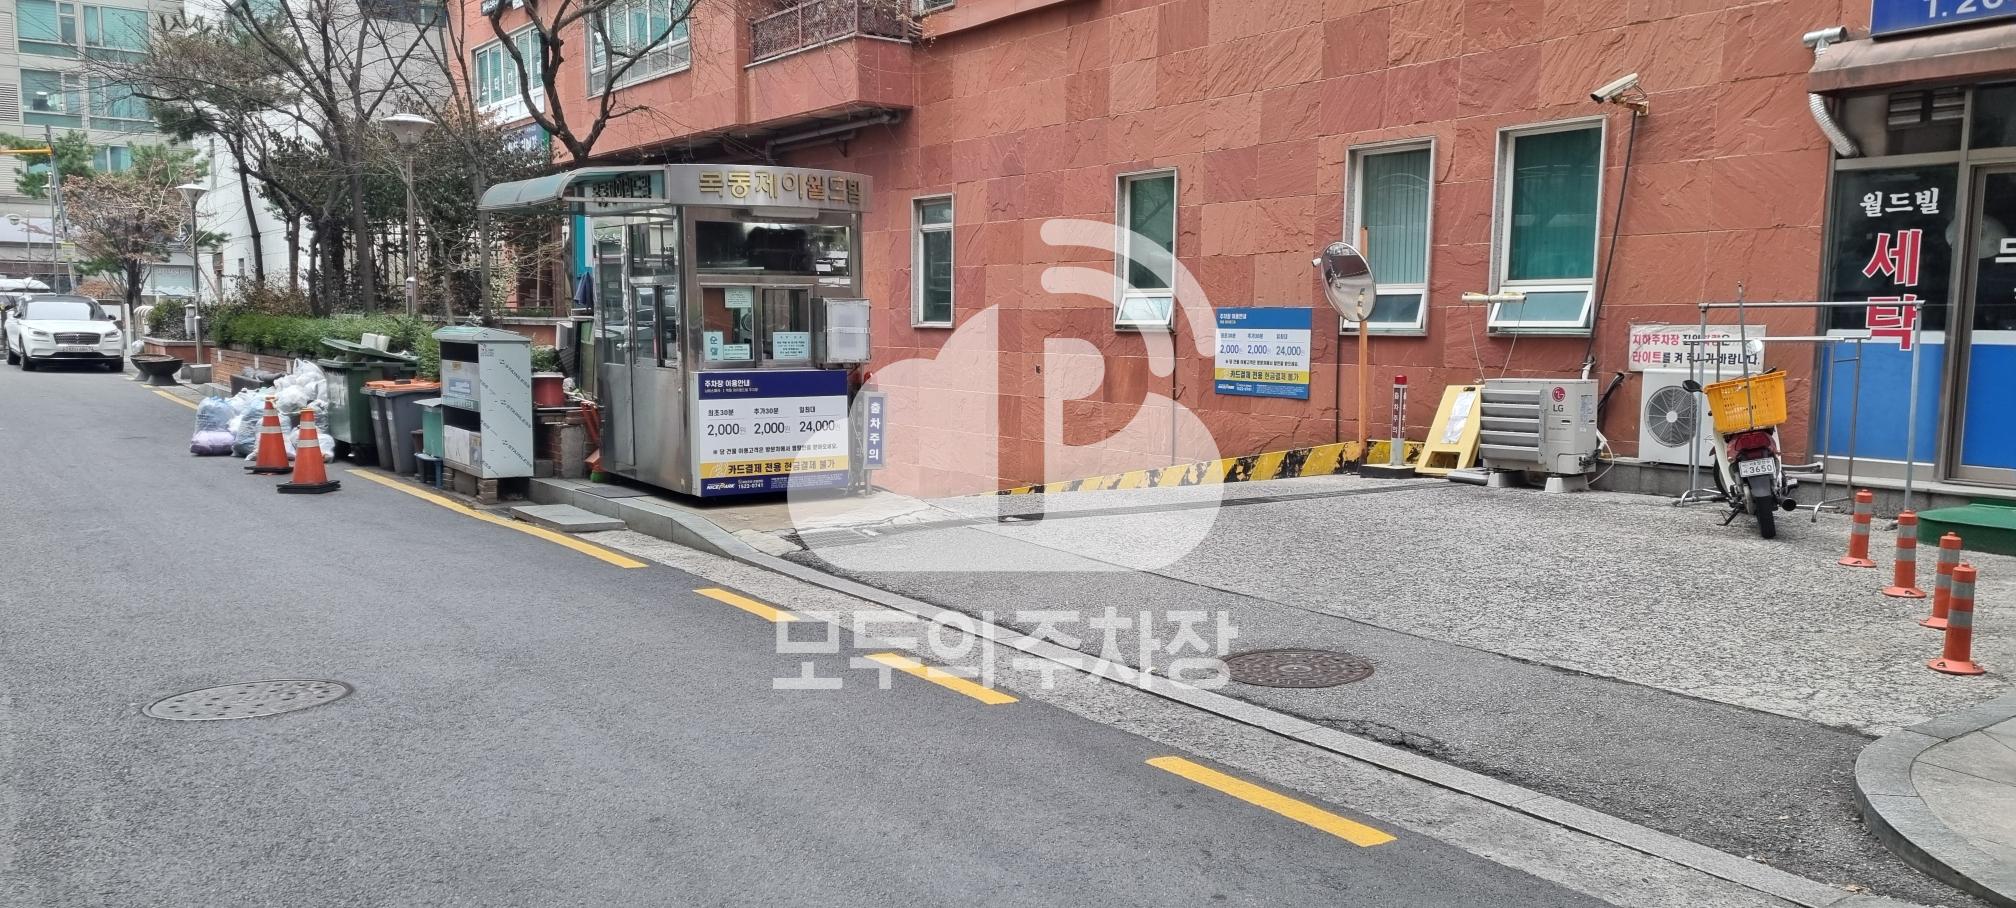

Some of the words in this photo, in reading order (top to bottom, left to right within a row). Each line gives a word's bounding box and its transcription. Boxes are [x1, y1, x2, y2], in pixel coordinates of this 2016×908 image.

[700, 170, 861, 204] 목동제이월드빌
[1860, 187, 1940, 218] 월드빌
[1862, 229, 1922, 351] 세탁
[1632, 334, 1680, 347] 지하주차장
[1632, 351, 1671, 364] 라이트를
[1674, 352, 1683, 364] 켜
[704, 380, 723, 388] 주차장
[725, 379, 750, 388] 이용안내
[708, 409, 734, 417] 최초30분
[754, 407, 779, 415] 추가30분
[1552, 404, 1564, 413] LG
[868, 402, 881, 460] 출차주의
[727, 463, 762, 475] 카드결제
[765, 462, 782, 473] 전용
[784, 459, 817, 472] 현금결제
[1749, 465, 1773, 474] 3650
